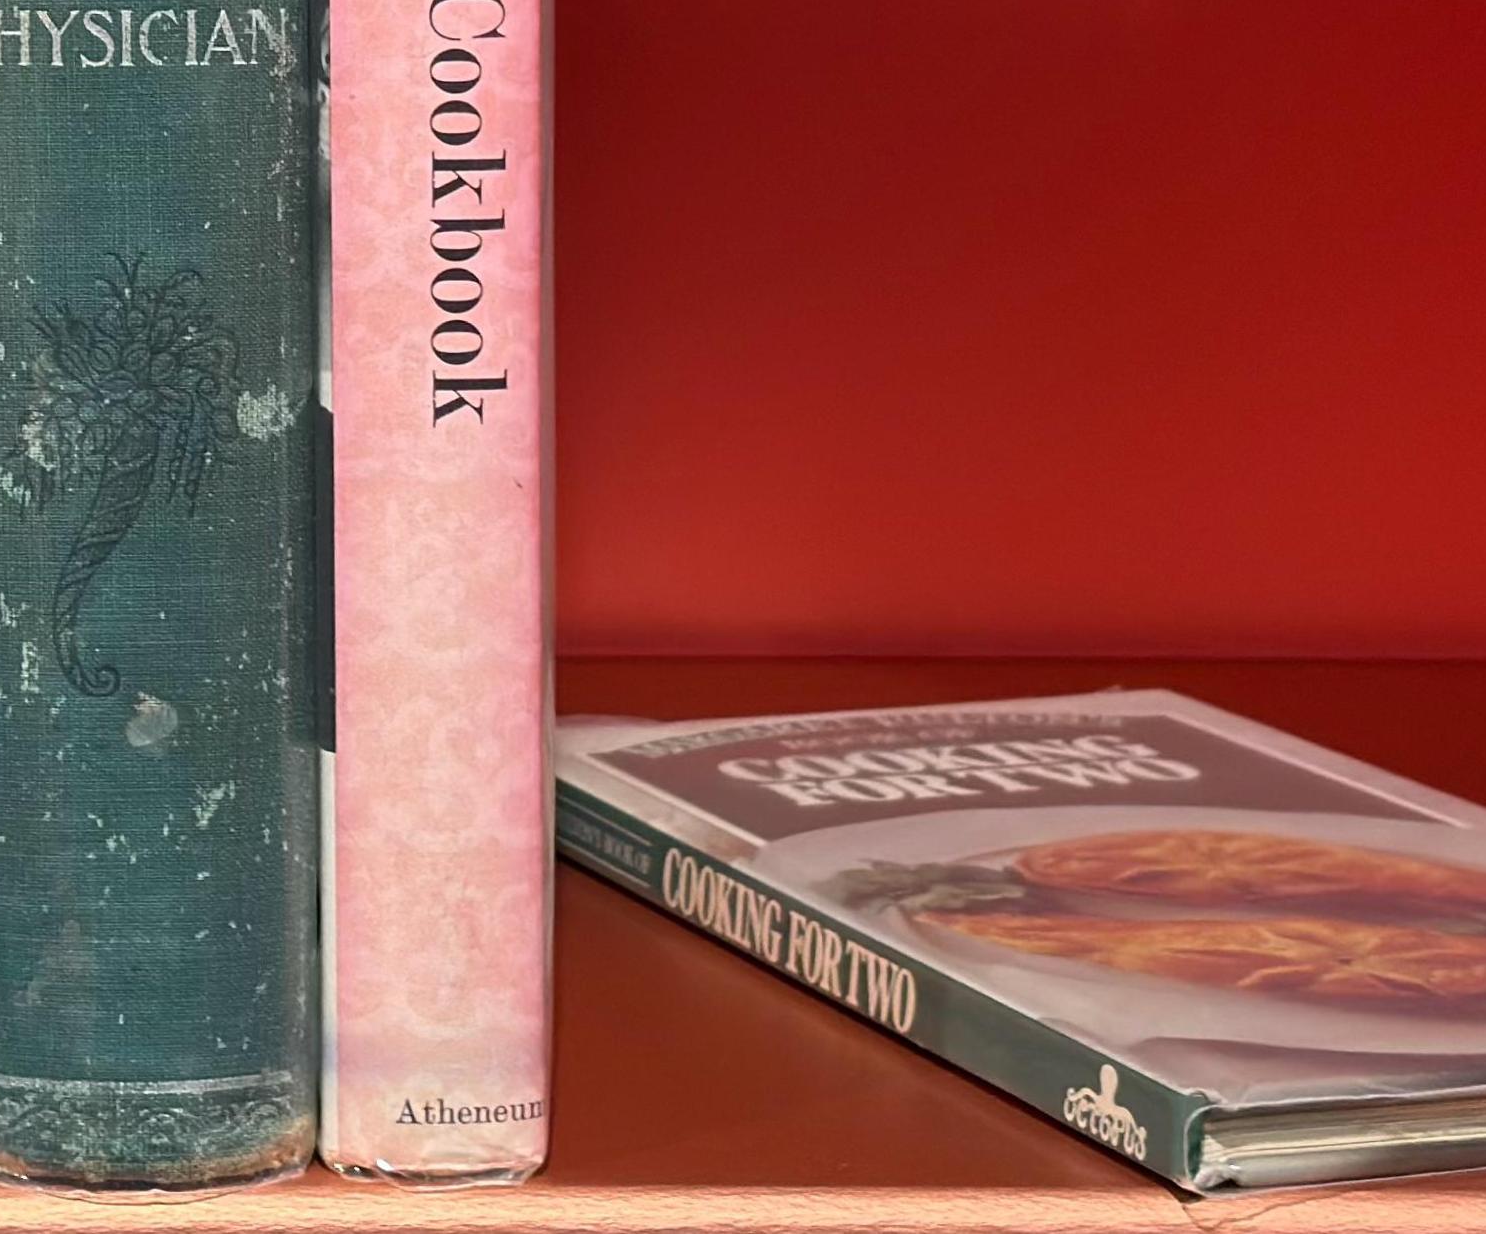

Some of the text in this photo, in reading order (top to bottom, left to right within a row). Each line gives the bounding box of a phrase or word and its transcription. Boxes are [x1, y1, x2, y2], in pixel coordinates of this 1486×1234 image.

[717, 735, 1159, 782] COOKING
[757, 758, 1200, 806] FOR TWO
[663, 848, 916, 1034] COOKING FOR TWO
